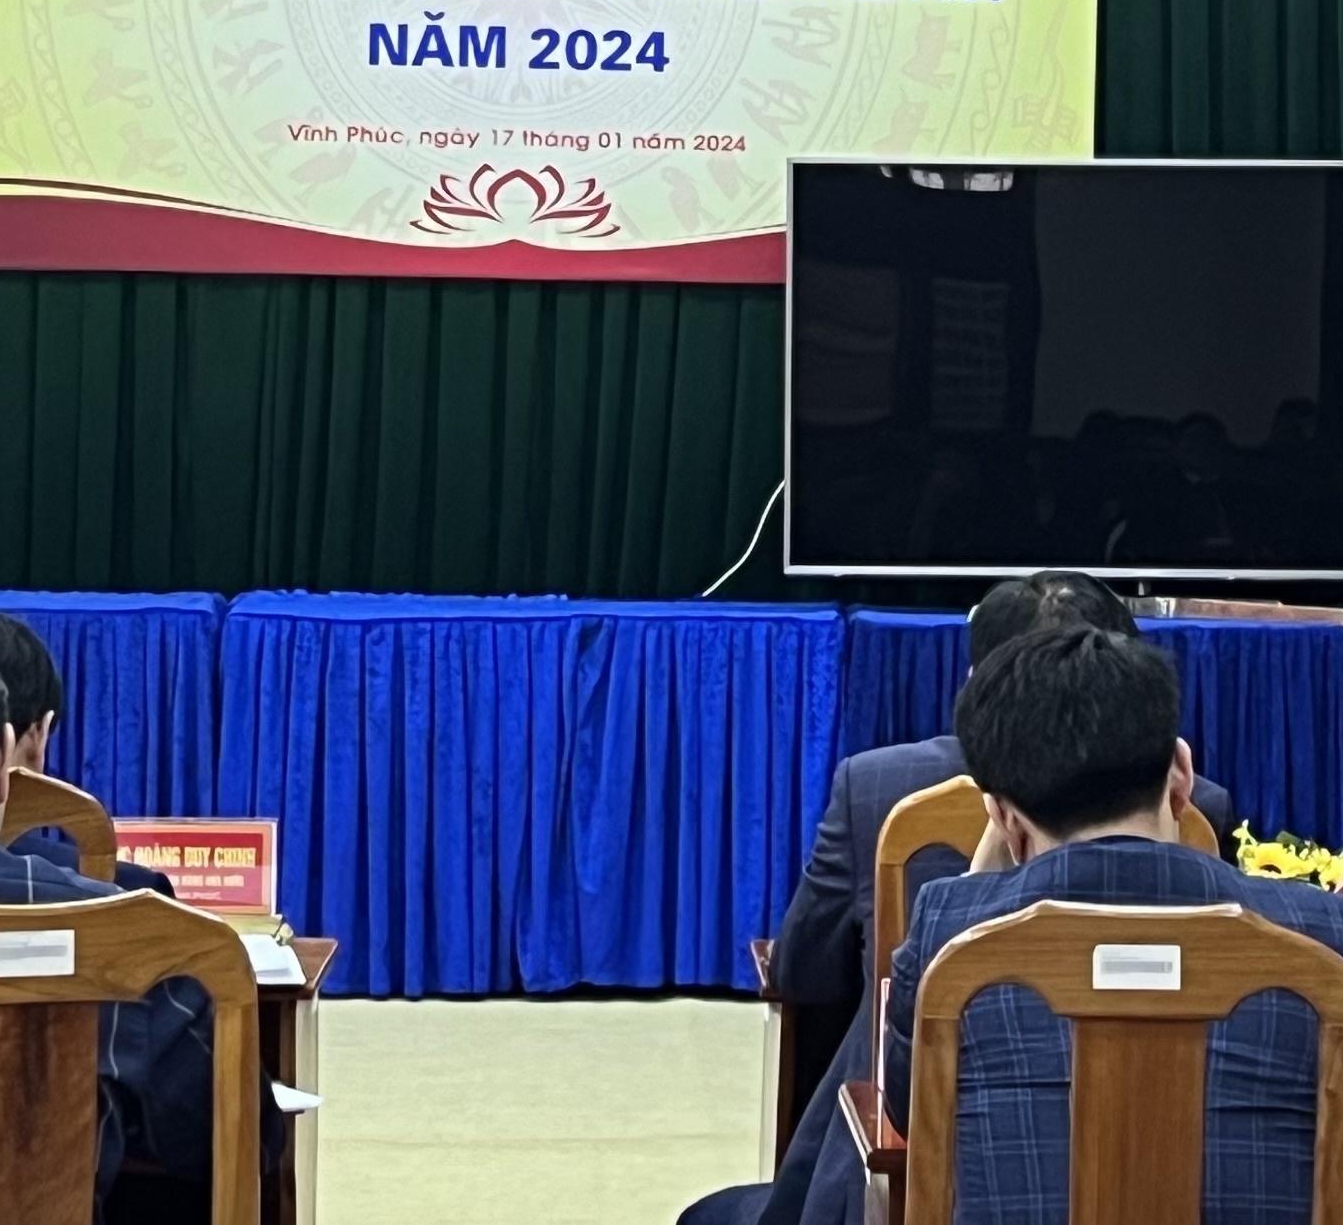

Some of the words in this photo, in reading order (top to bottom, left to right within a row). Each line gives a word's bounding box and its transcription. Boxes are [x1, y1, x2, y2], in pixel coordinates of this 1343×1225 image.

[368, 10, 506, 68] NĂM
[529, 28, 669, 72] 2024
[288, 124, 337, 142] Vĩnh
[420, 127, 480, 148] ngày
[492, 130, 513, 147] 17
[523, 130, 589, 151] tháng
[598, 131, 621, 149] 01
[632, 133, 685, 150] năm
[693, 134, 745, 152] 2024
